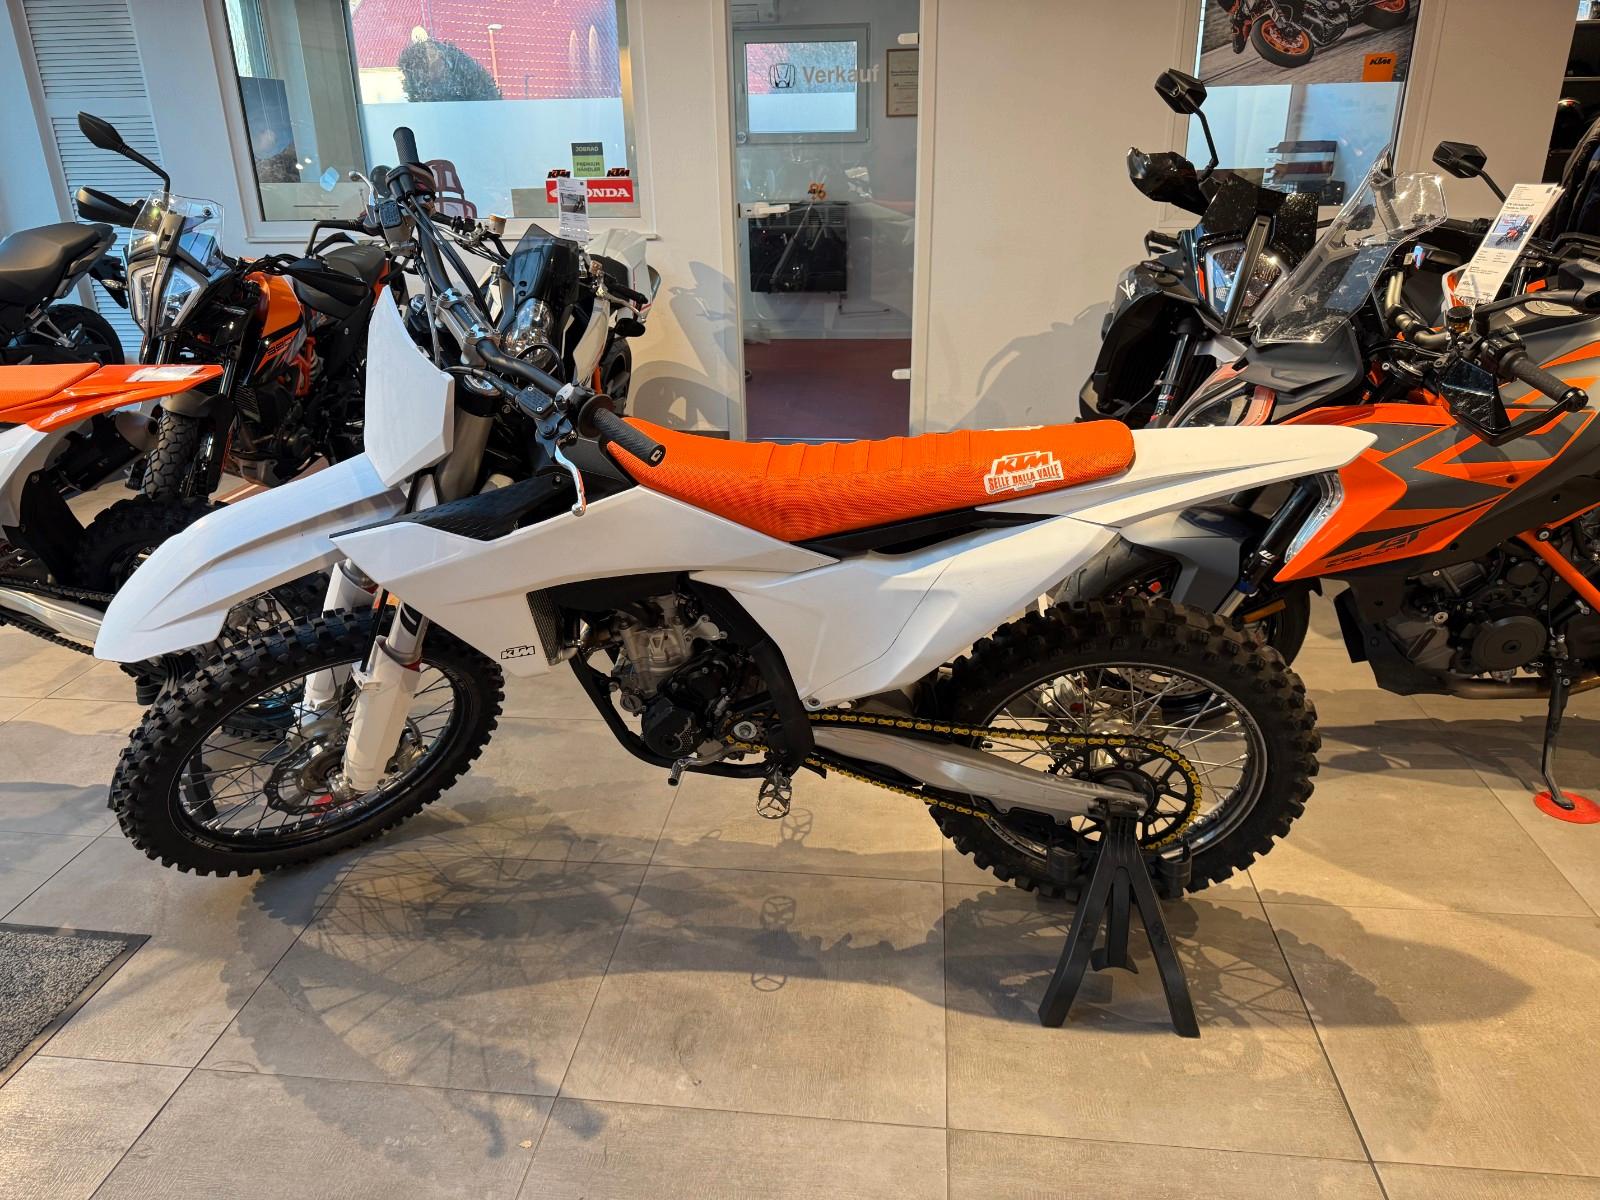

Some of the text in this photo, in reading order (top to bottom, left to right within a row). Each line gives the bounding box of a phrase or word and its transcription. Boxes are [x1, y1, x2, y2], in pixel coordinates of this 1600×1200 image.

[803, 65, 880, 83] Verkauf
[547, 169, 571, 178] KTM
[606, 168, 630, 177] KTM
[586, 188, 630, 198] ONDA
[991, 451, 1053, 476] KTM
[1036, 463, 1060, 480] VALLE
[501, 645, 536, 660] KTM
